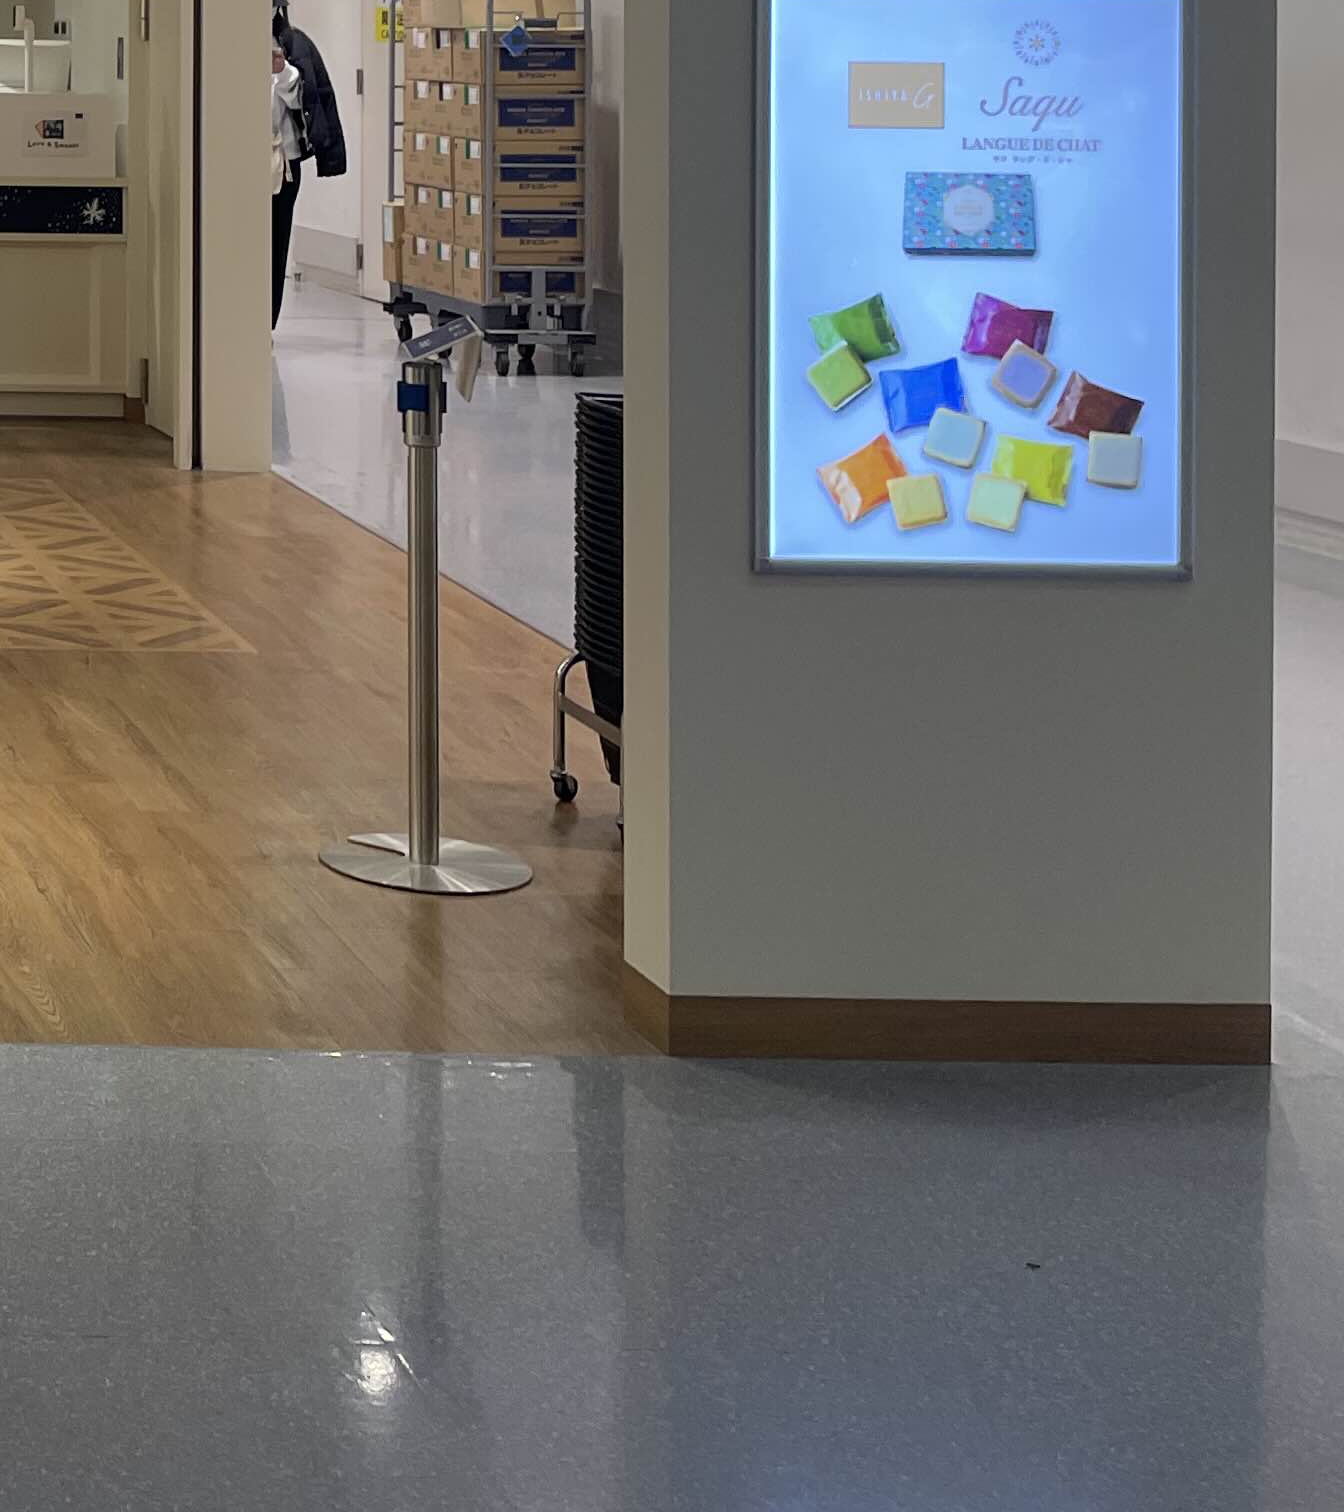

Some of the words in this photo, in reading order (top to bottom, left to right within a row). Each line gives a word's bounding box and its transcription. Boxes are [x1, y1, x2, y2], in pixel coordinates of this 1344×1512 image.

[961, 137, 1031, 151] LANGUE
[1032, 138, 1055, 152] DE
[1056, 138, 1103, 153] CHAT
